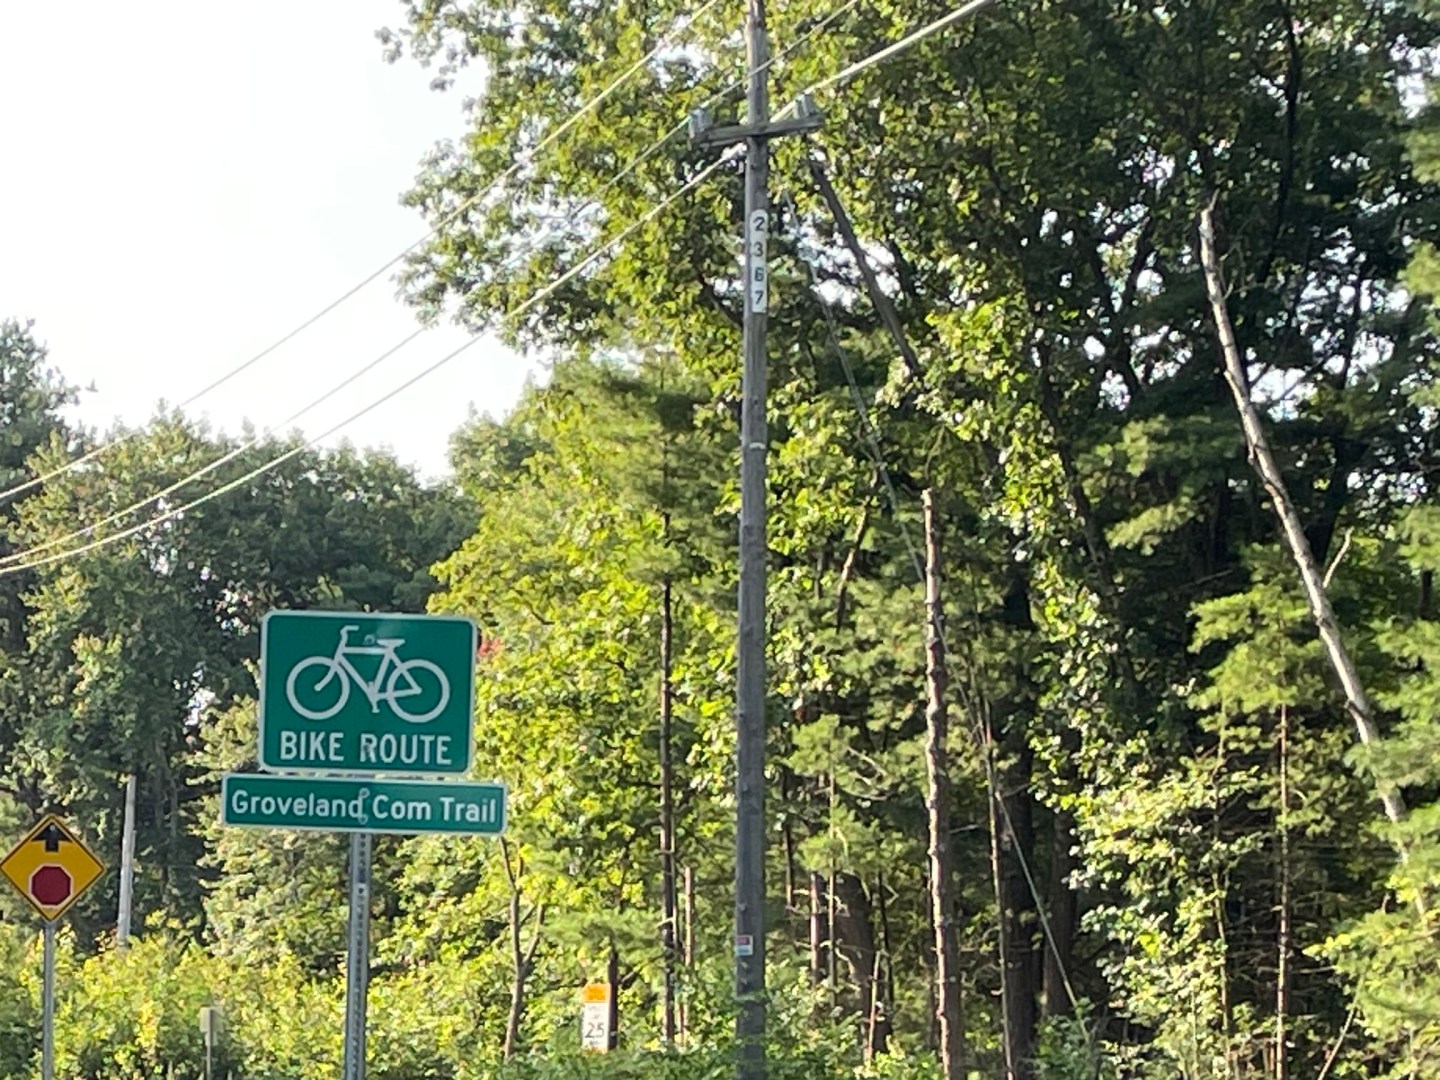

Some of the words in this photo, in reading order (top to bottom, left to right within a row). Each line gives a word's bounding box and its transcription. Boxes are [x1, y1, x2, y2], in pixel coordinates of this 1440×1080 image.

[752, 216, 766, 305] 2367
[280, 730, 344, 761] BIKE
[360, 733, 452, 765] ROUTE
[231, 790, 364, 818] Groveland
[372, 795, 432, 820] Com
[440, 796, 496, 823] Trail
[584, 1022, 605, 1039] 25
